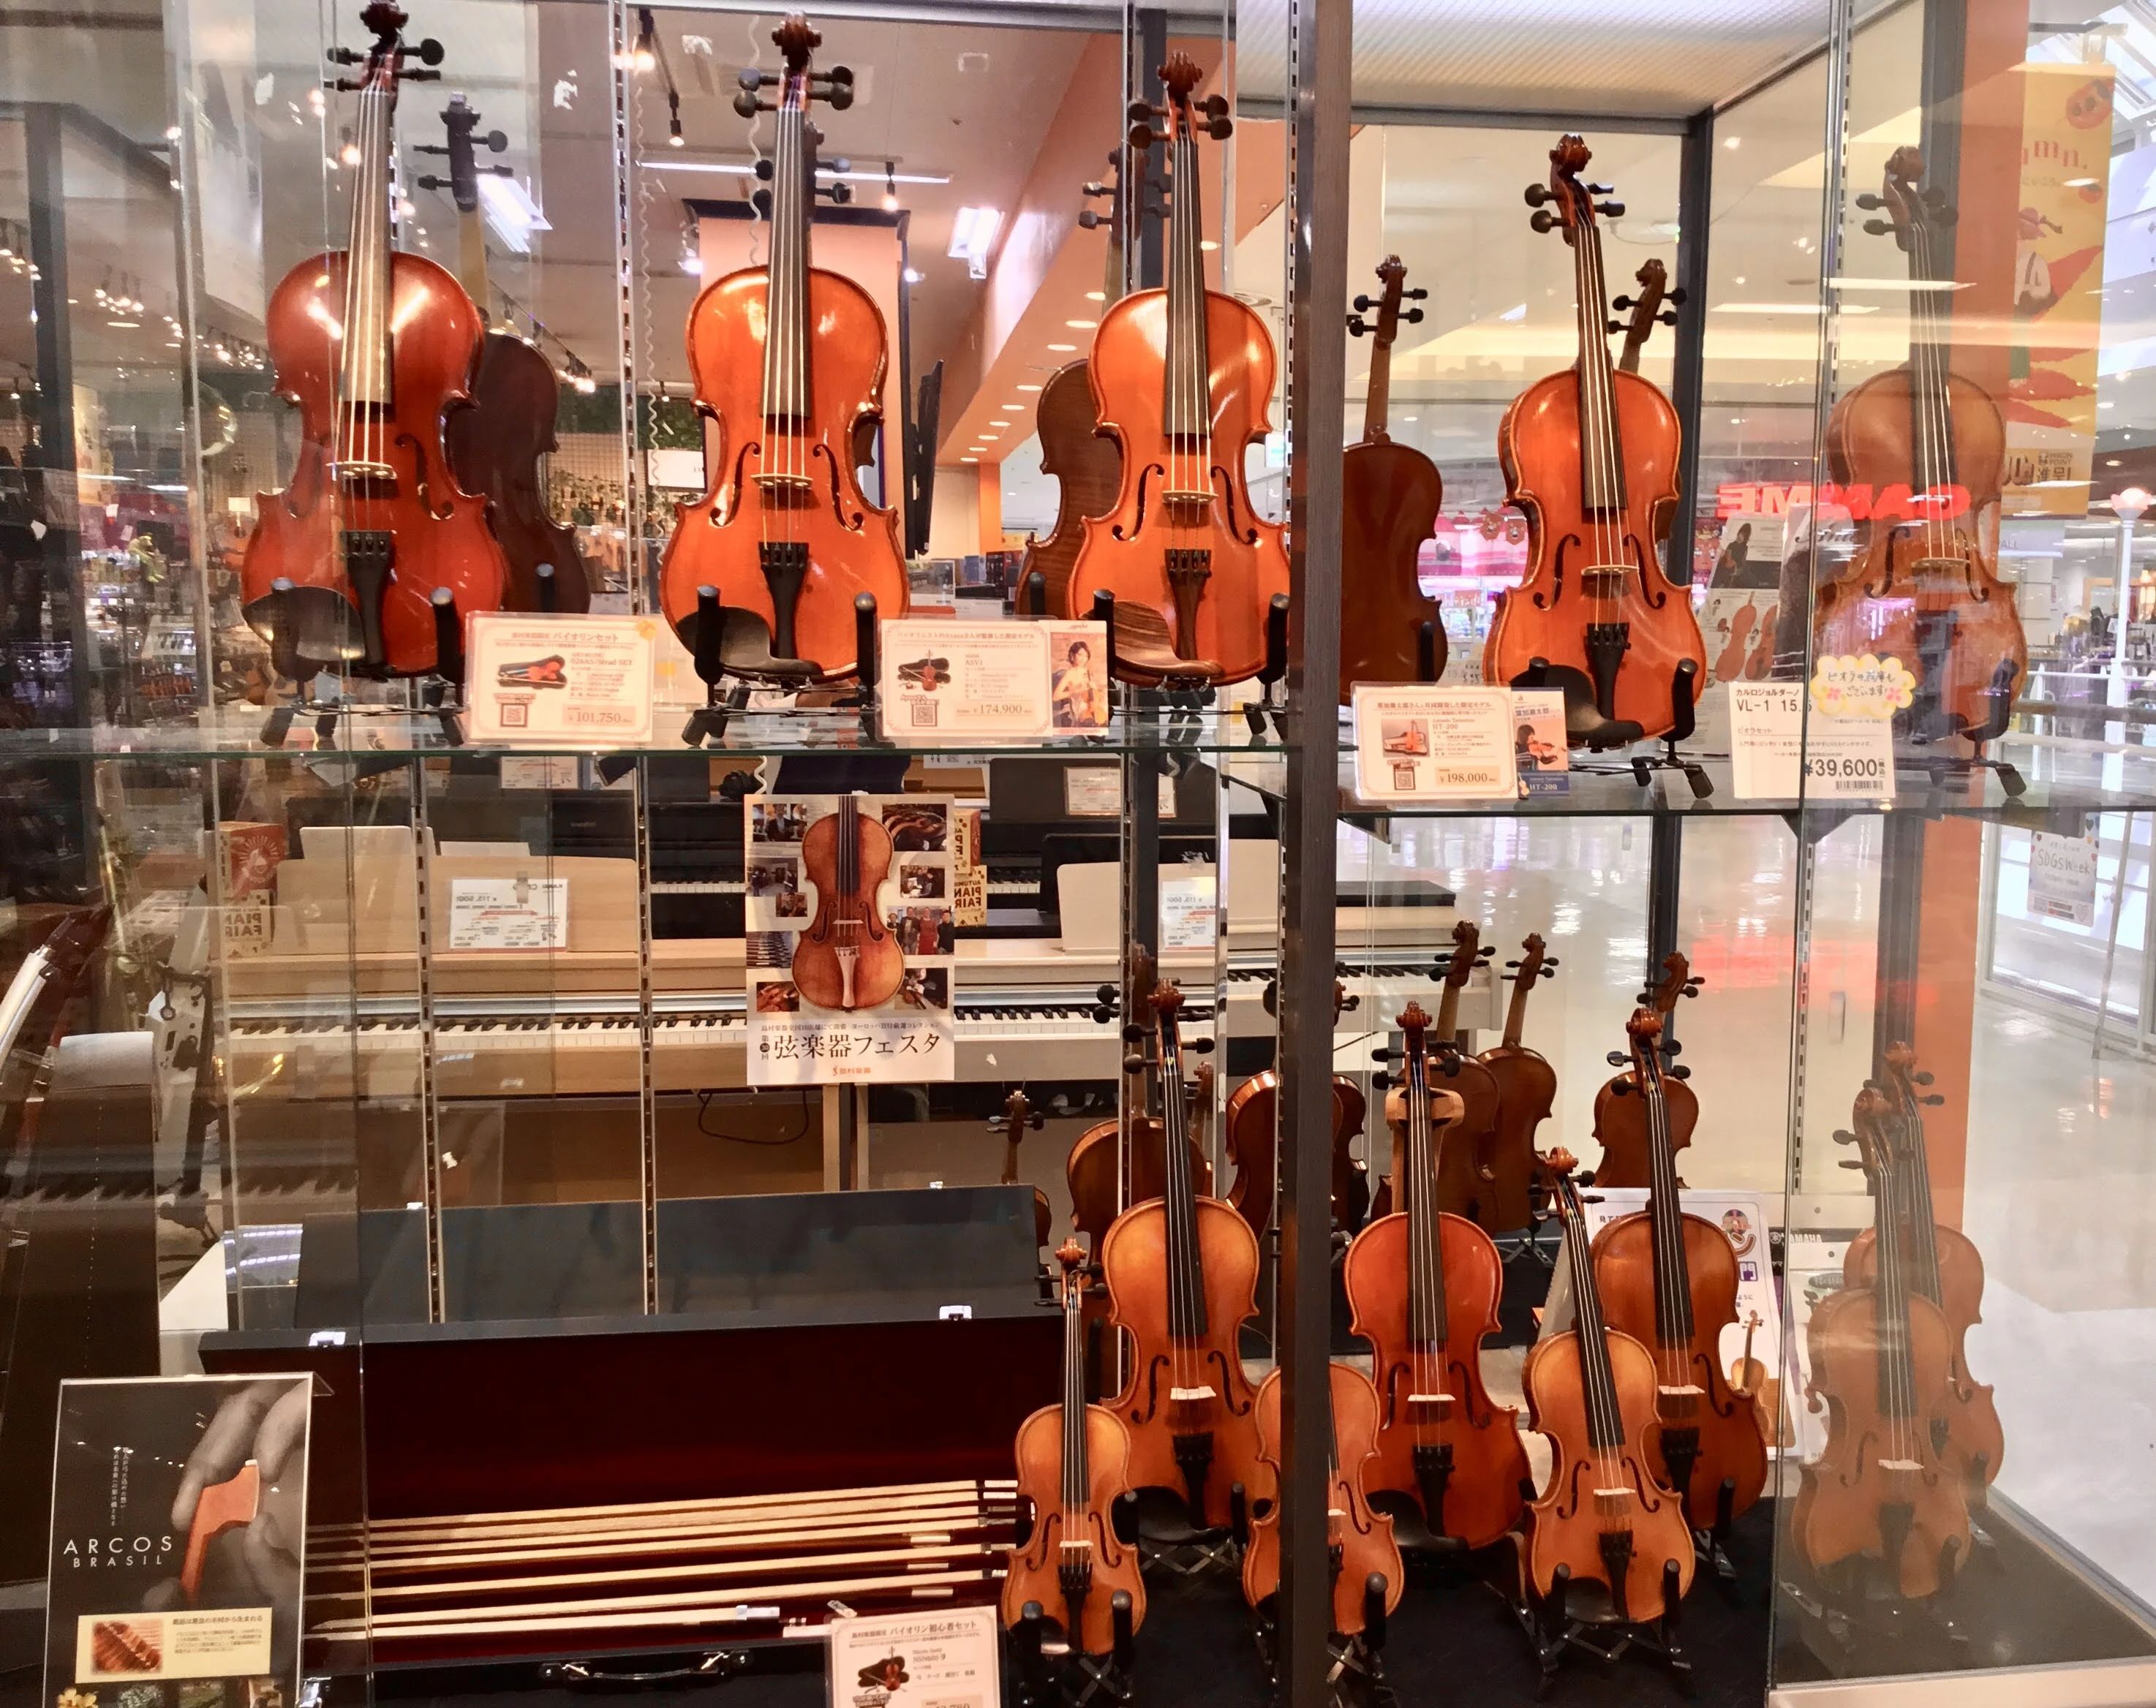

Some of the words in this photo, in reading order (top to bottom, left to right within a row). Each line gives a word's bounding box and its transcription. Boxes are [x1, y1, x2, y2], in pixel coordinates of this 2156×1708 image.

[774, 1032, 941, 1060] 弦楽器フェスタ
[63, 1535, 173, 1555] ARCOS
[72, 1554, 162, 1568] BRASIL
